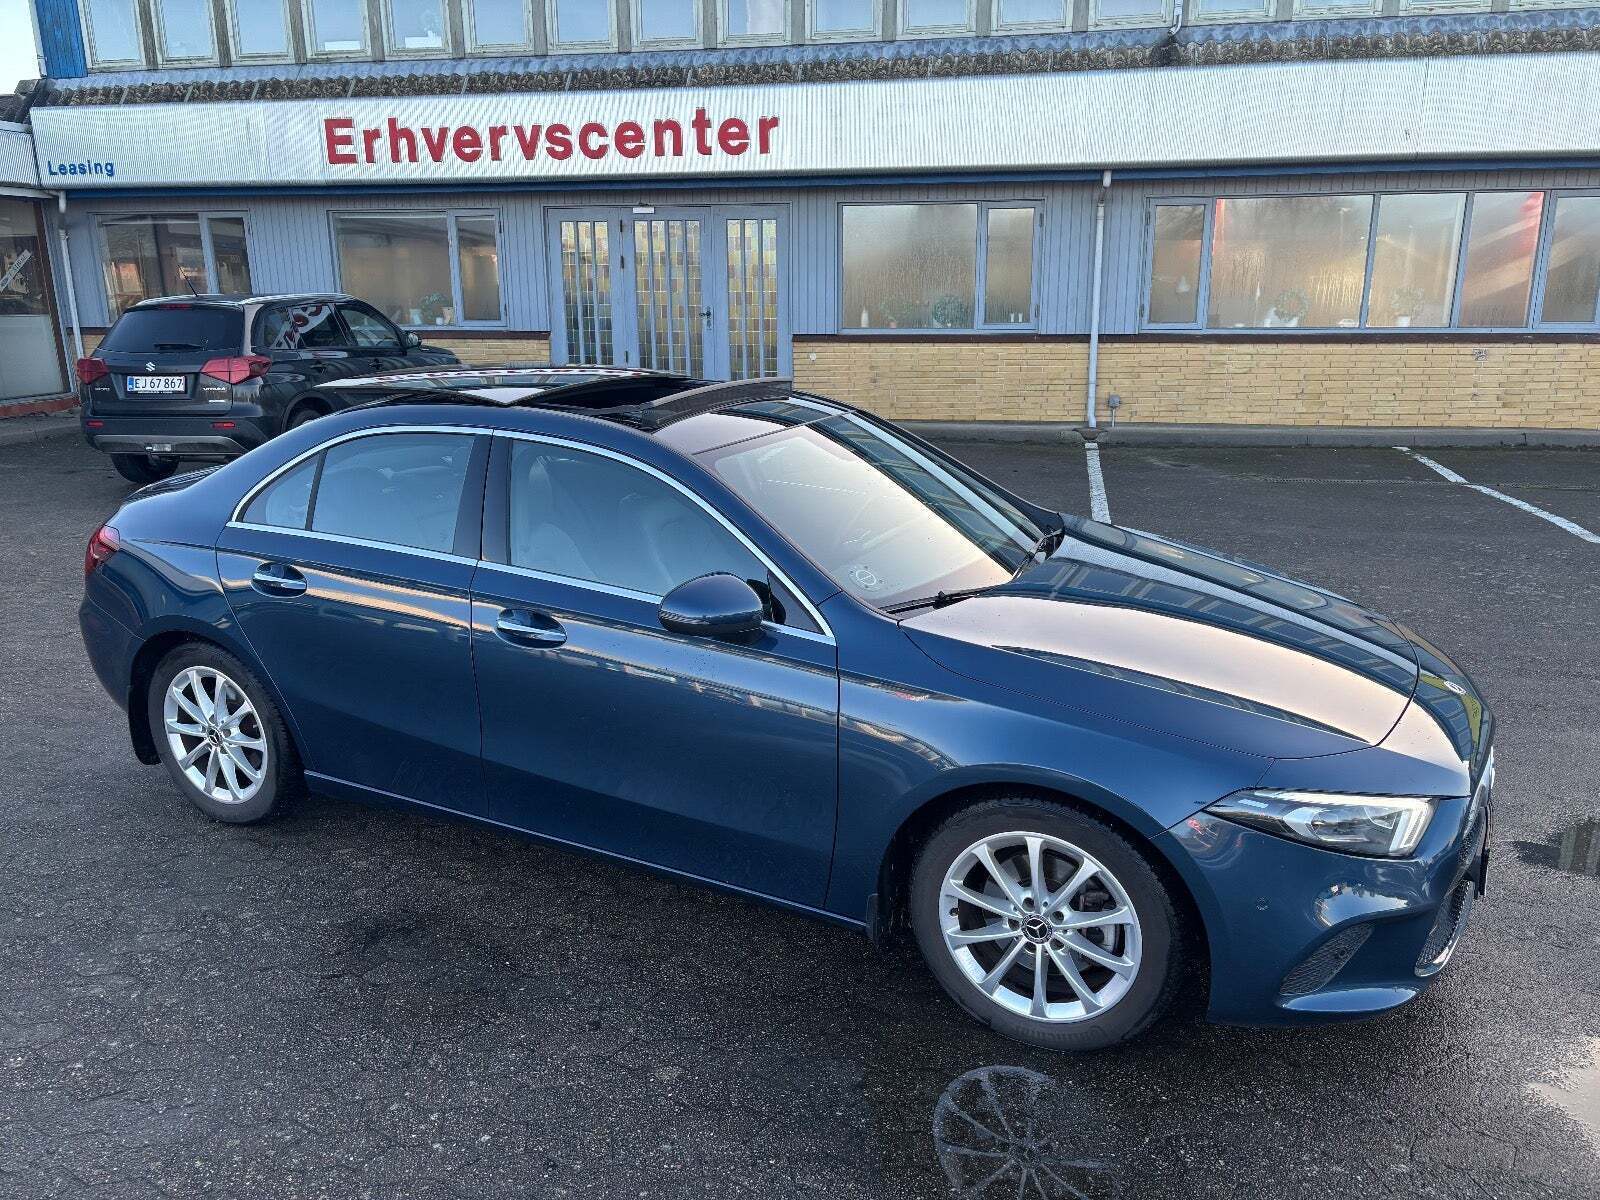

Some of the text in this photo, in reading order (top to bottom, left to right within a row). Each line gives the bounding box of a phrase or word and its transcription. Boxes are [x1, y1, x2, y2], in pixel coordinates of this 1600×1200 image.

[324, 107, 780, 165] Erhvervscenter
[48, 160, 115, 177] Leasing
[134, 378, 147, 389] EJ
[149, 378, 162, 389] 67
[163, 378, 183, 389] 867
